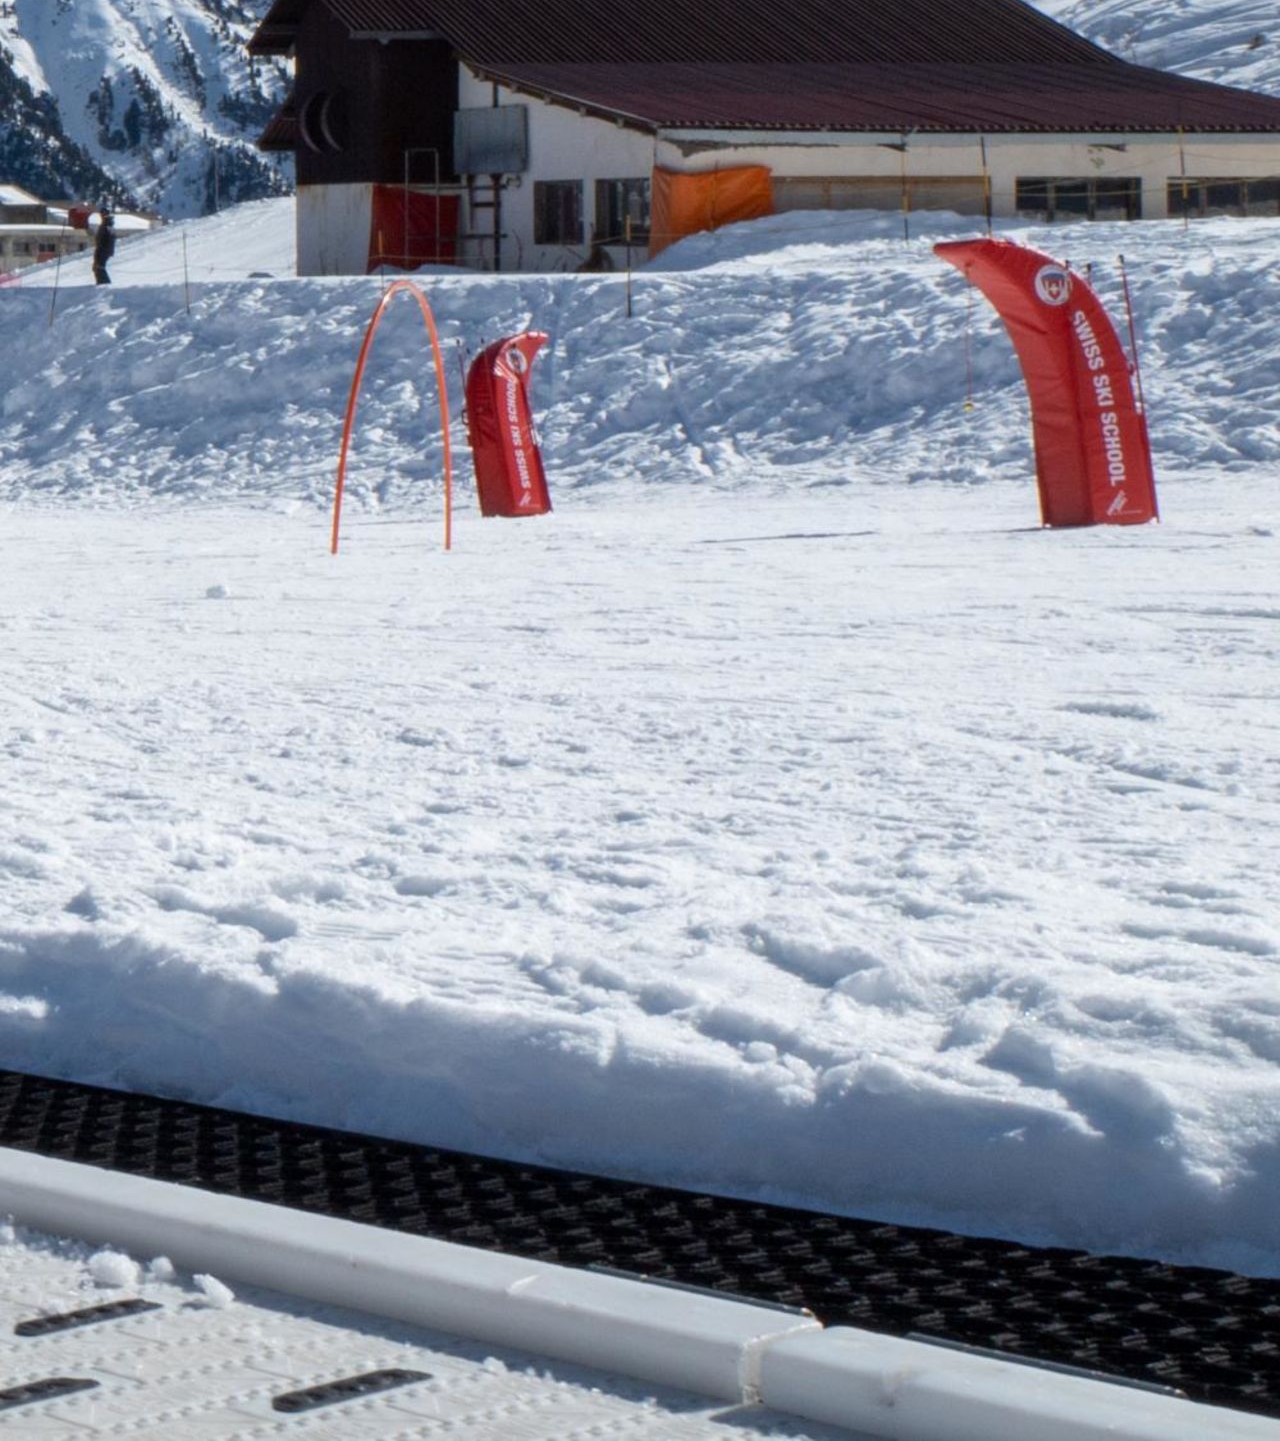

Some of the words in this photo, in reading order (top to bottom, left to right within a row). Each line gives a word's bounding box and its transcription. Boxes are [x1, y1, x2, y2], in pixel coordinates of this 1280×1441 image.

[1072, 310, 1104, 370] SWISS
[1093, 374, 1115, 407] SKI
[511, 425, 522, 447] SKI
[1100, 412, 1126, 487] SCHOOL
[515, 449, 532, 489] SWISS
